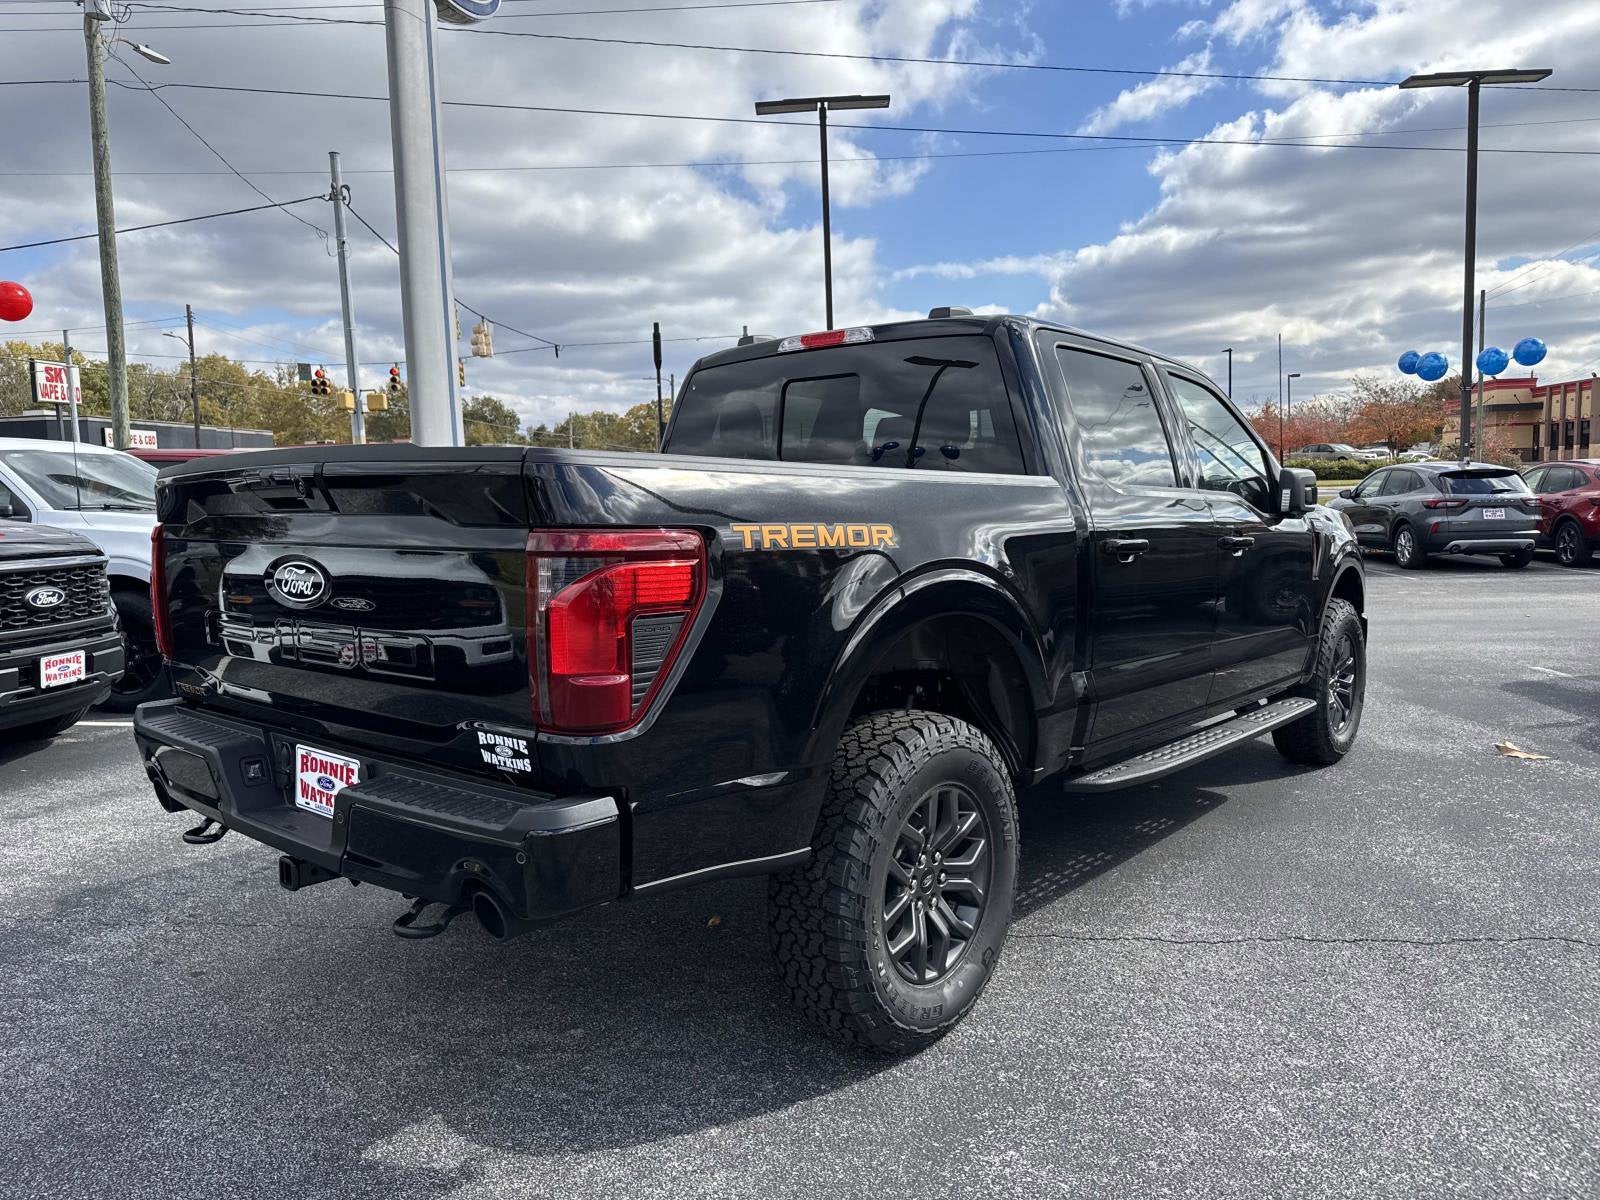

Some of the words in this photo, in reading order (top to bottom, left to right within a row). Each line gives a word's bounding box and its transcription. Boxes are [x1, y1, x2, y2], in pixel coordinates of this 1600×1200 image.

[39, 383, 59, 401] VAPE
[60, 385, 66, 401] &
[144, 435, 156, 446] CBD
[730, 523, 899, 550] TREMOR
[281, 566, 315, 596] Ford
[44, 655, 82, 671] RONNIE
[45, 667, 82, 682] WATKINS
[477, 731, 529, 755] RONNIE
[300, 753, 355, 787] RONNIE
[480, 748, 532, 772] WATKINS
[300, 778, 337, 808] WATK
